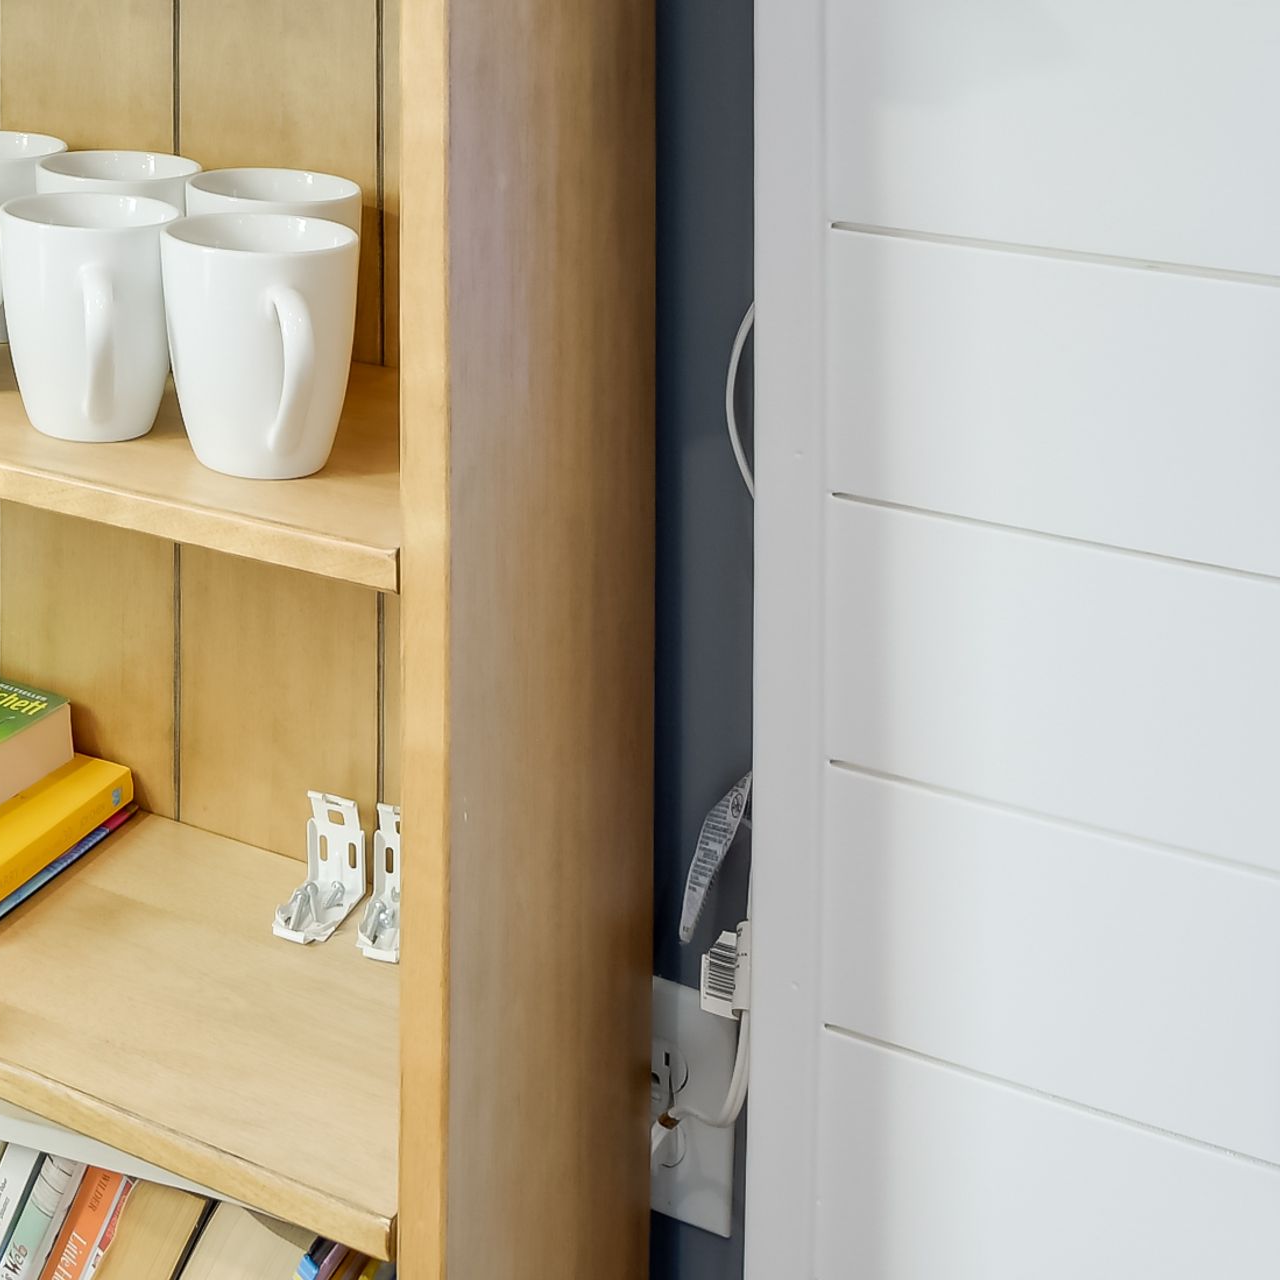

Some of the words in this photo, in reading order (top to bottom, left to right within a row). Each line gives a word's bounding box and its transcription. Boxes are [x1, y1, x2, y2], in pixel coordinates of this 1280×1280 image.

[88, 1173, 111, 1214] WILDER
[3, 1241, 28, 1276] Web
[61, 1231, 88, 1268] Little
